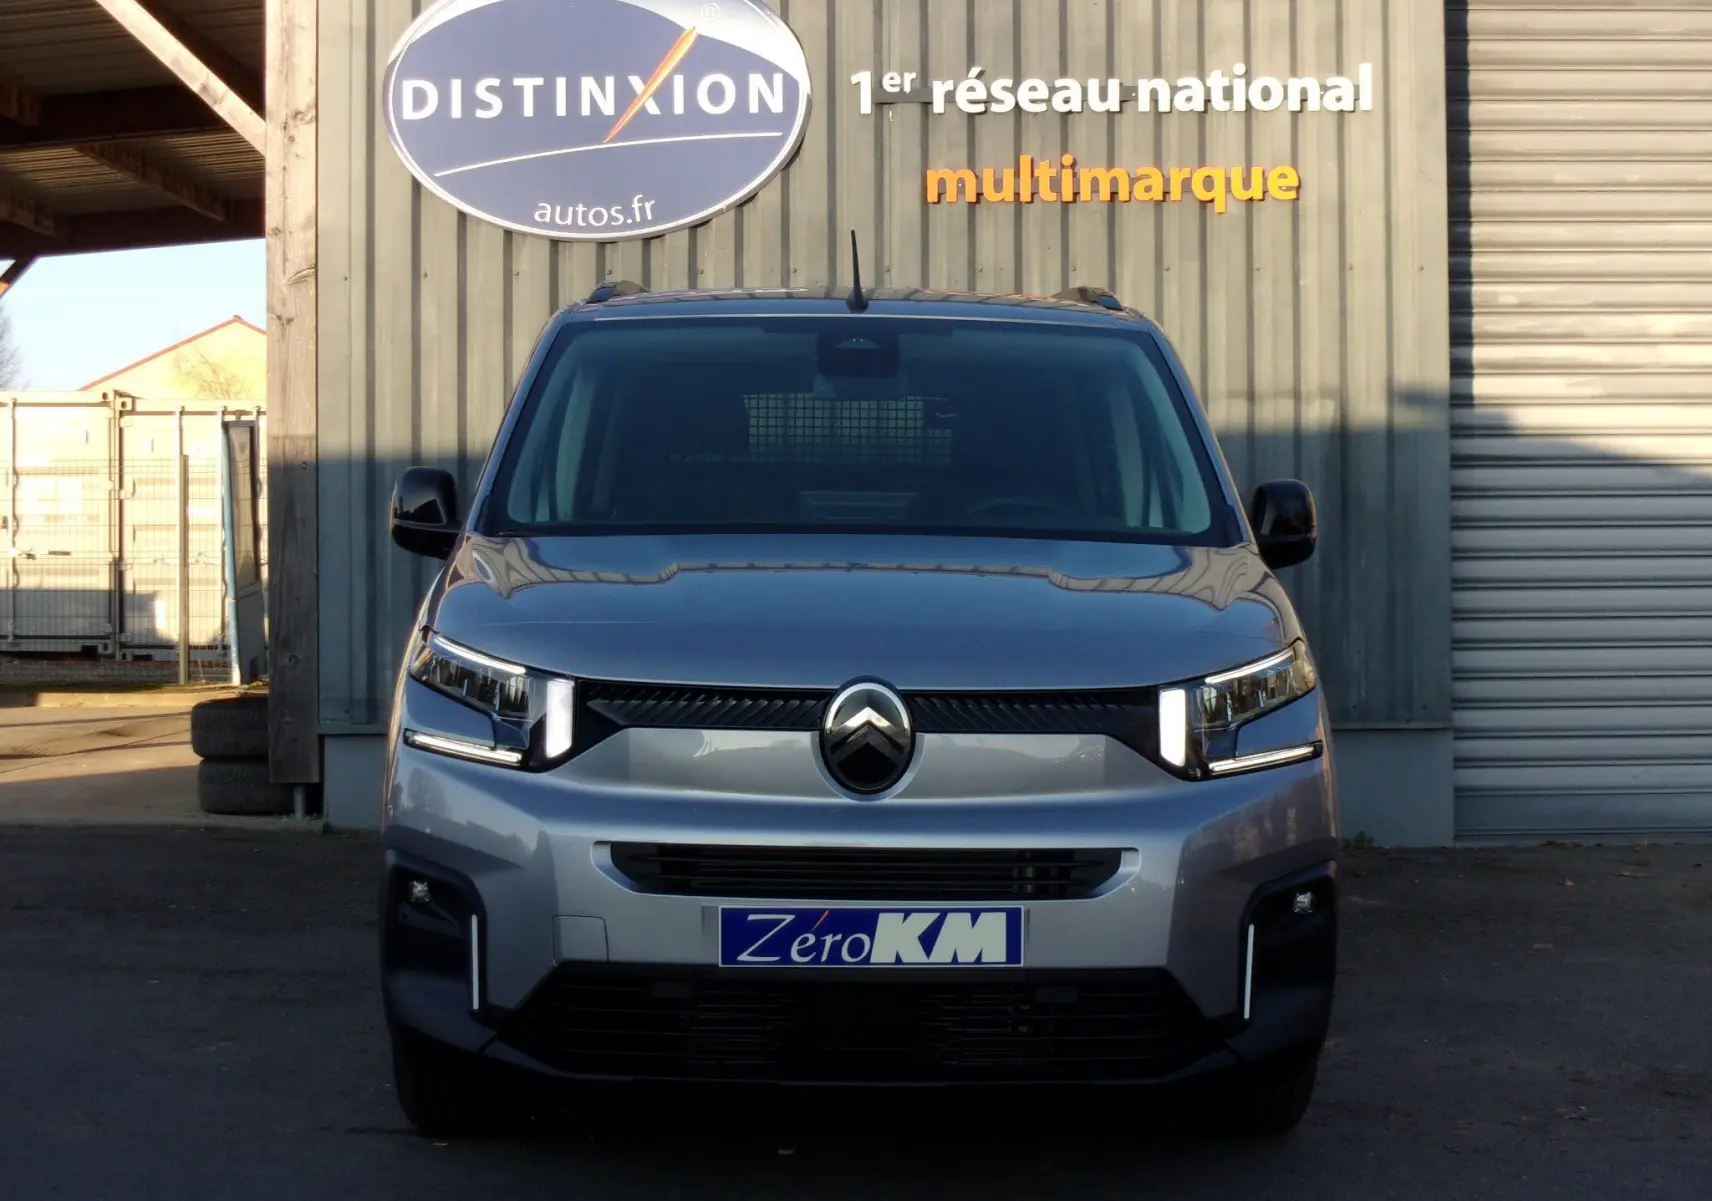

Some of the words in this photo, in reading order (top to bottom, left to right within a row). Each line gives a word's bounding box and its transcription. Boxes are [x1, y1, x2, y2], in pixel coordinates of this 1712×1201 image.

[401, 73, 785, 121] DISTINXION
[931, 66, 1121, 115] réseau
[1137, 62, 1374, 113] national
[926, 154, 1301, 214] multimarque
[533, 193, 656, 227] autos.fr
